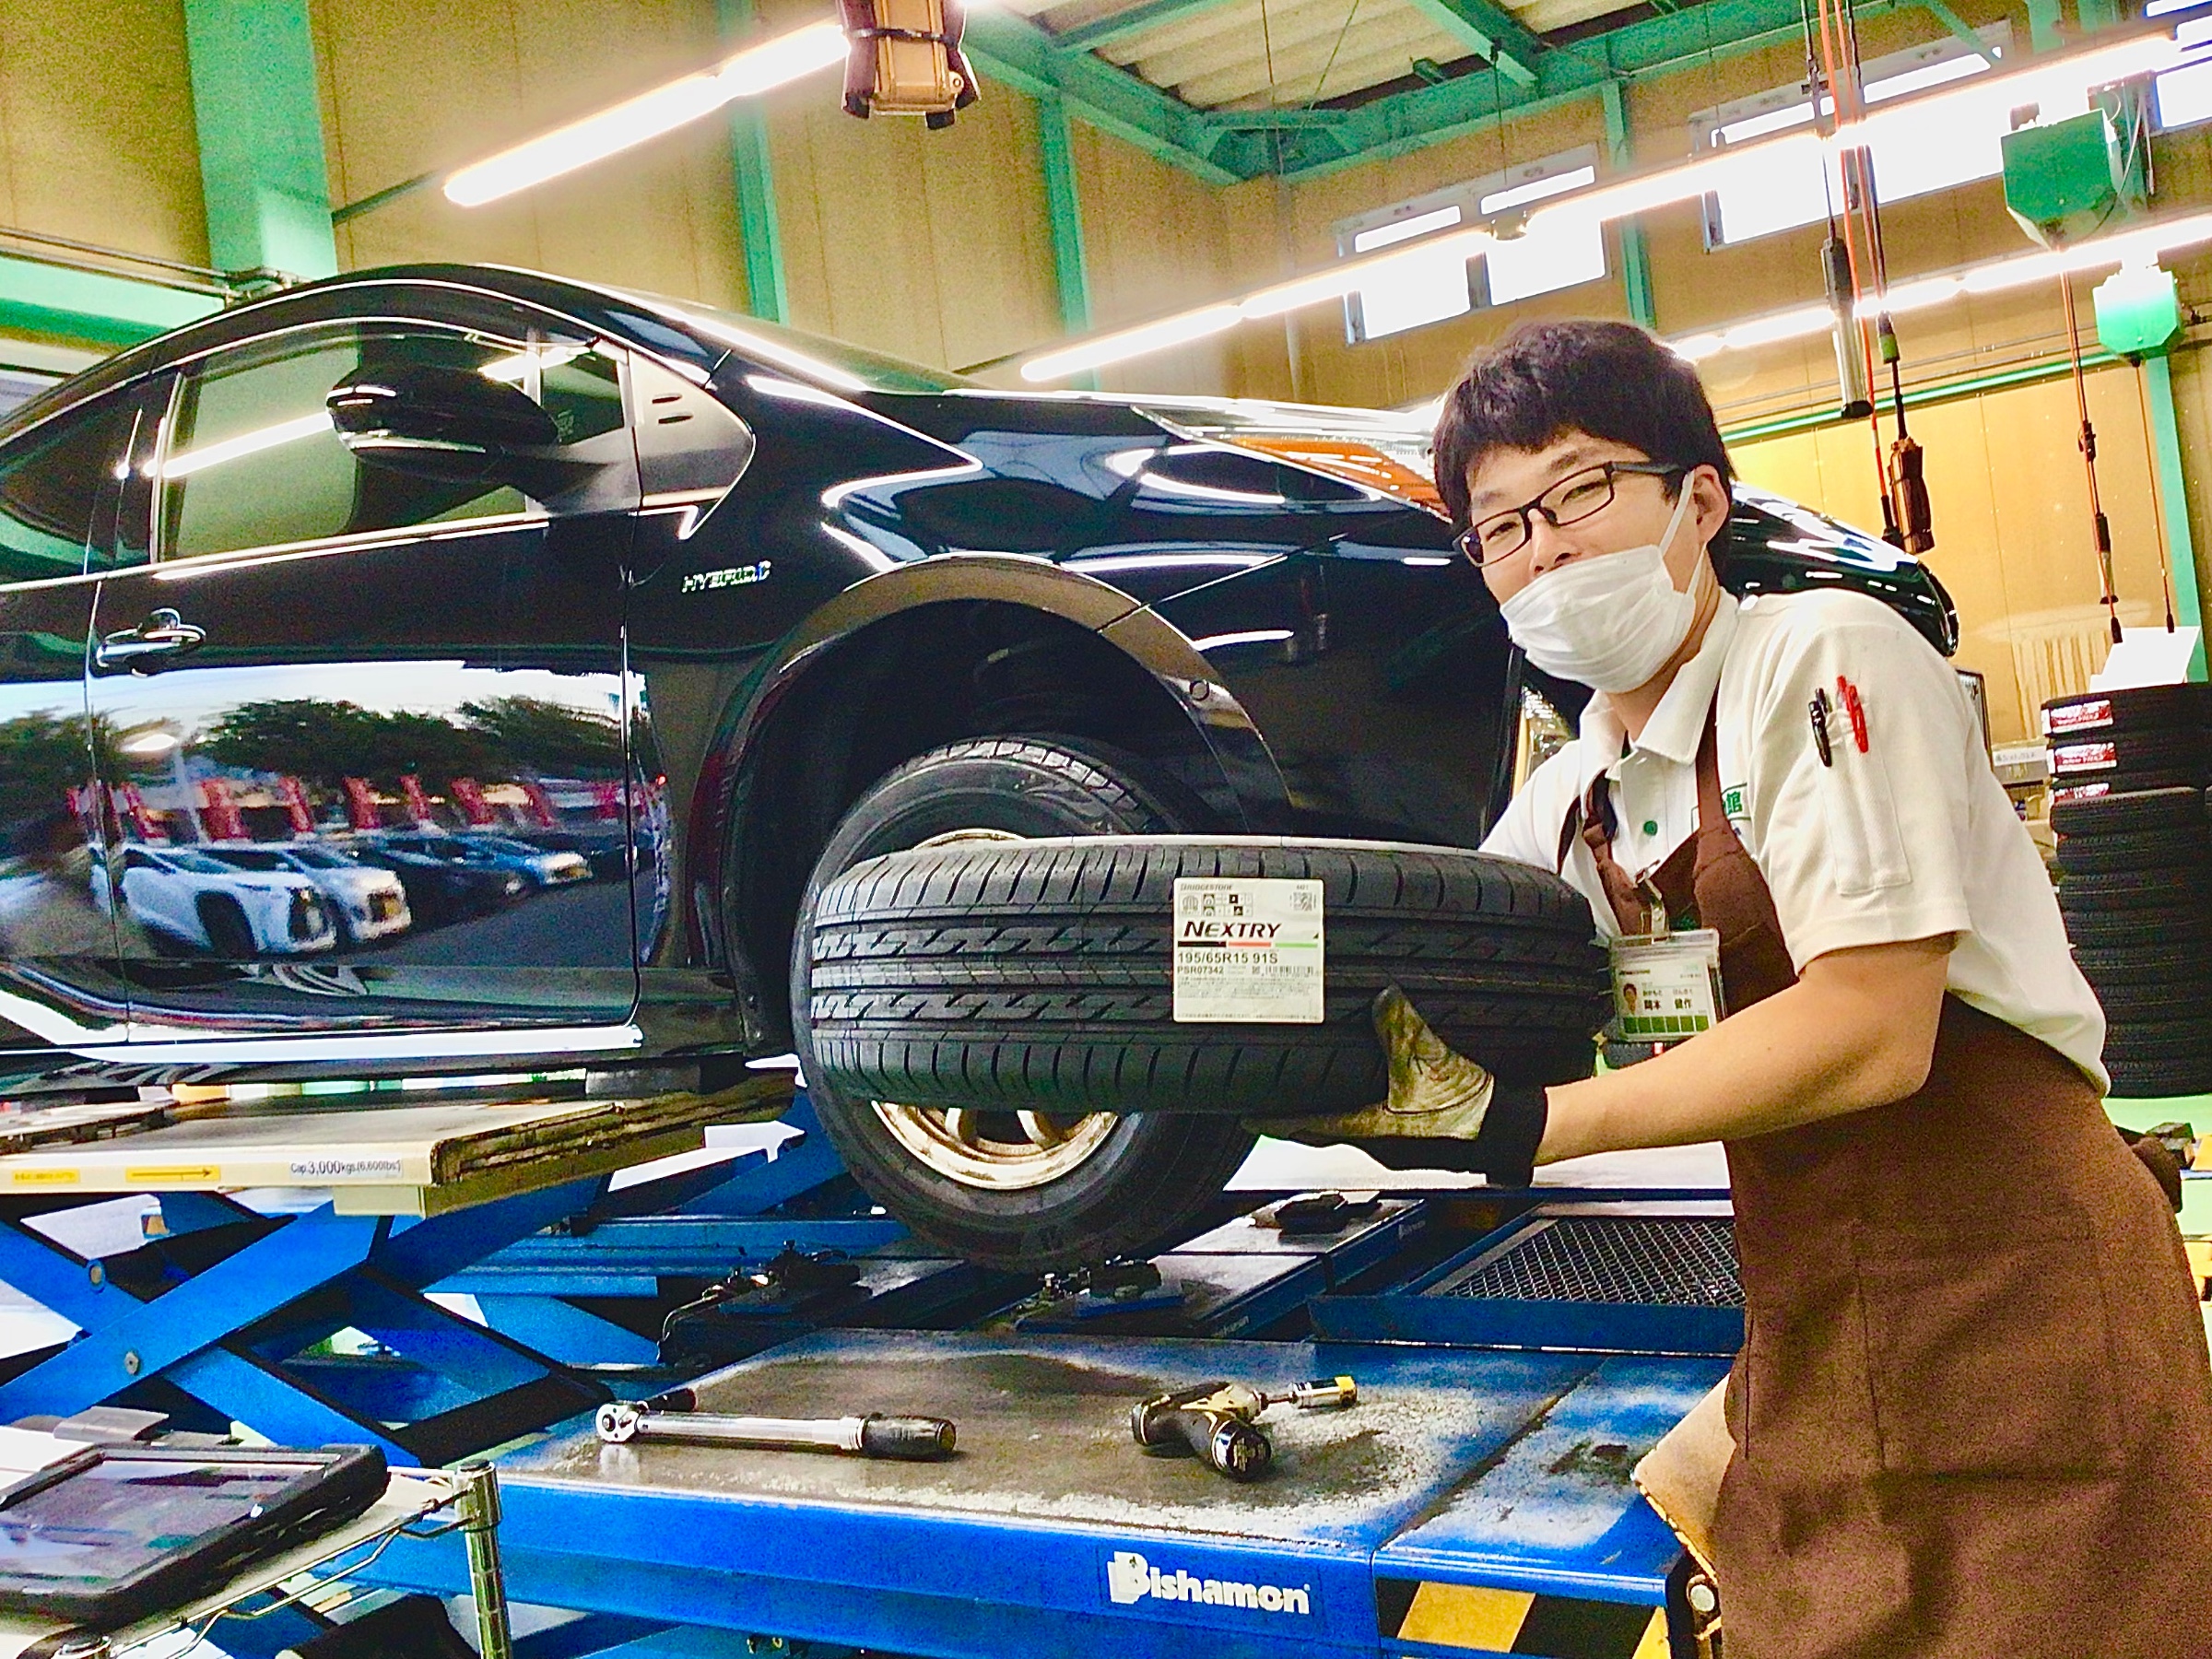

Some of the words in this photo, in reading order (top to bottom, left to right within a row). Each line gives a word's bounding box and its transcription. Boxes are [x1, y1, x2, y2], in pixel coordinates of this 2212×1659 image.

[1183, 920, 1282, 939] NEXTRY
[1178, 952, 1248, 964] 195/65R15
[1253, 953, 1278, 964] 91S
[1177, 966, 1225, 975] PSR07342
[1107, 1550, 1310, 1615] Bishamon
